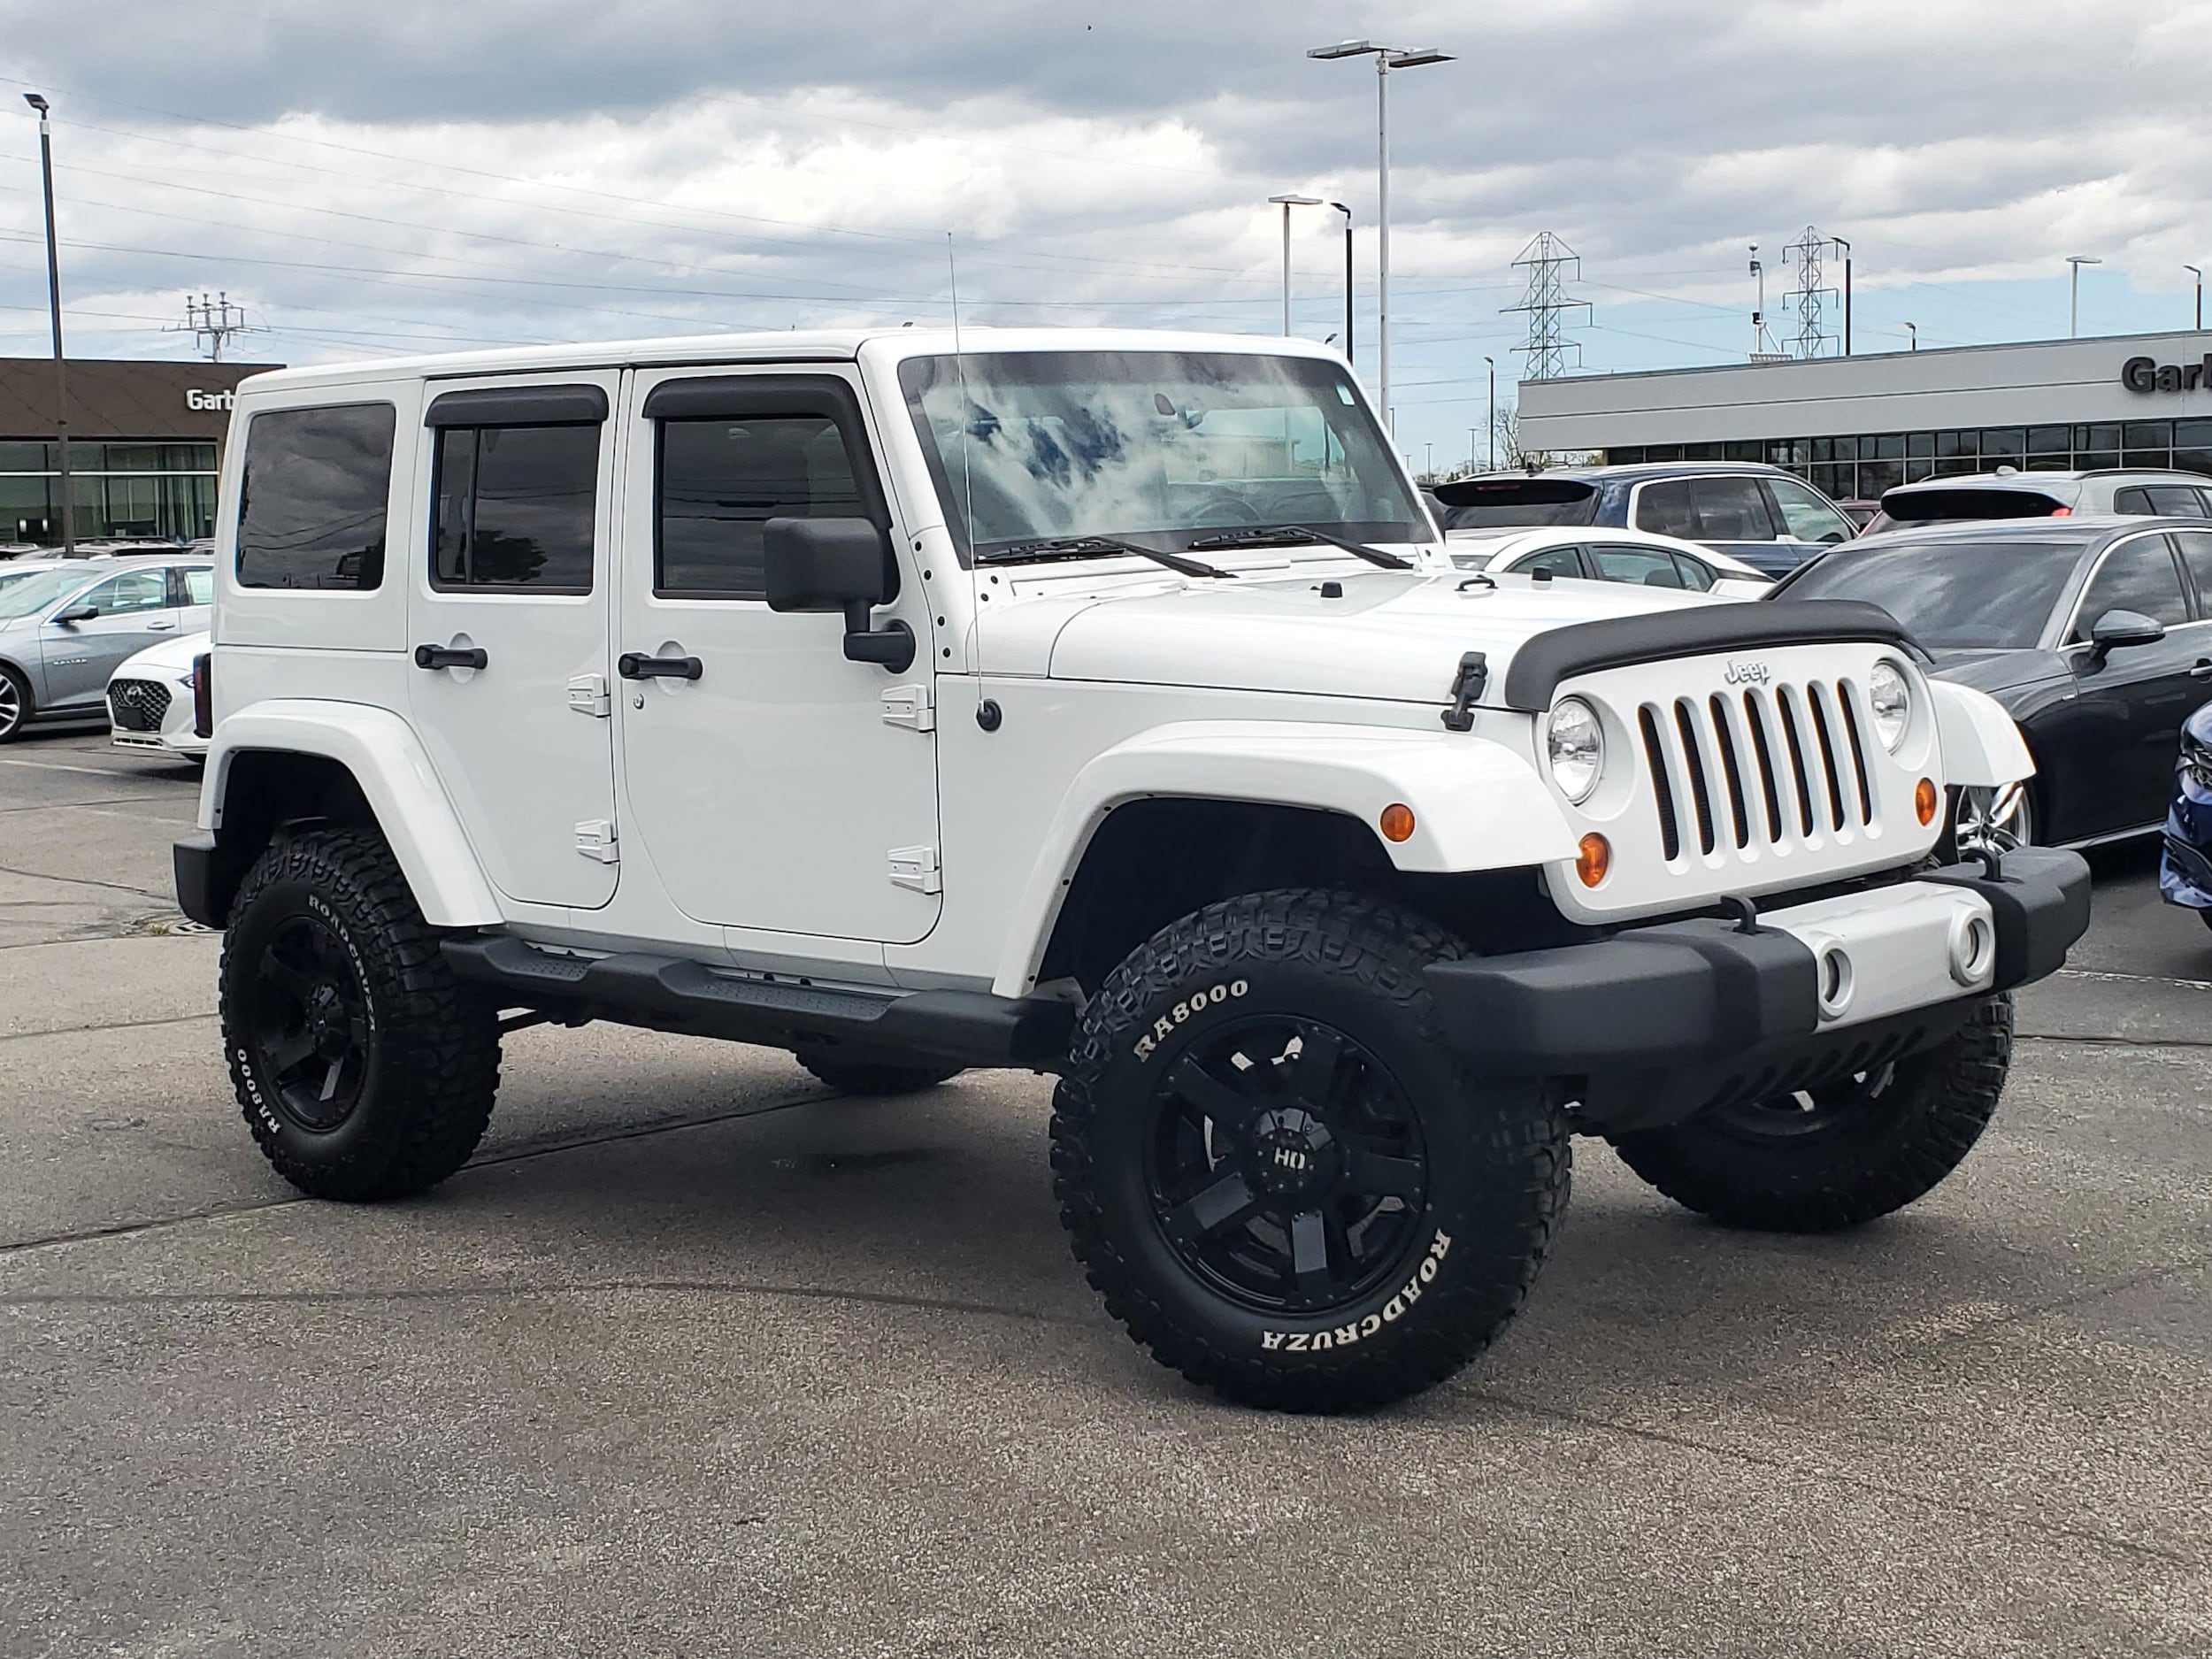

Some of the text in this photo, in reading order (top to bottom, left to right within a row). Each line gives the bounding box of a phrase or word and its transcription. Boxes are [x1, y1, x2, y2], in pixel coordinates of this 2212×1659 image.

[1724, 659, 1770, 686] Jeep
[1133, 979, 1248, 1063] RA8000
[237, 1048, 281, 1133] RA8000
[1261, 1227, 1451, 1352] ROADCRUZA
